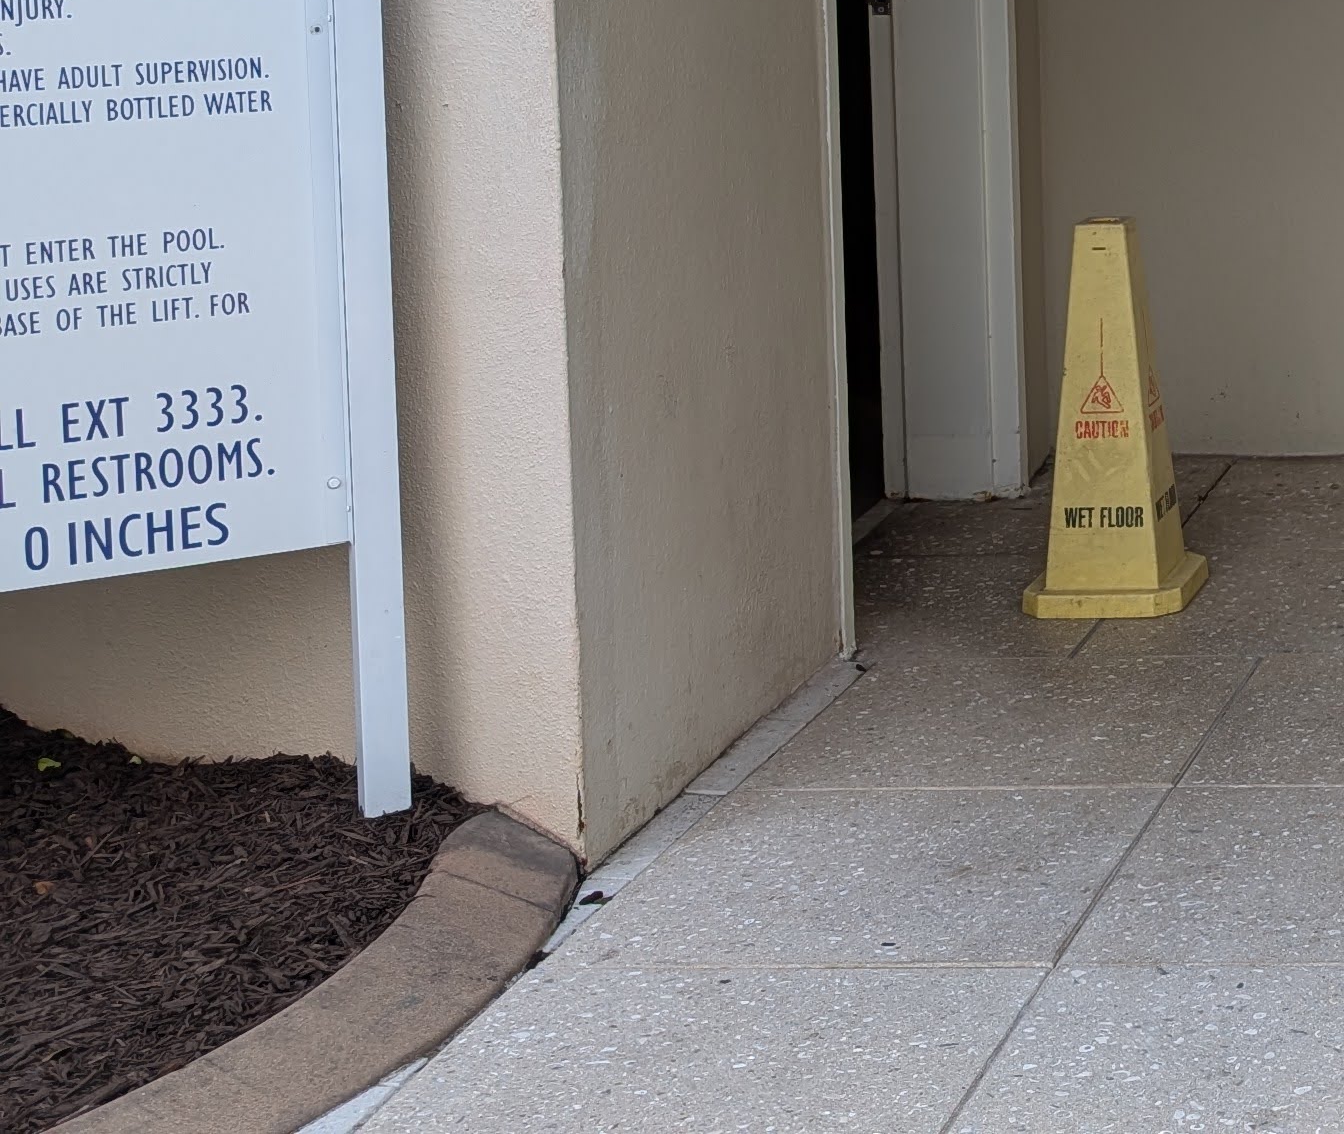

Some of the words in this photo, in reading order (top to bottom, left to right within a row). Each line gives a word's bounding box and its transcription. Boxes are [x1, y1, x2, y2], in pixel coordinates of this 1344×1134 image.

[58, 64, 122, 89] ADULT
[136, 57, 269, 85] SUPERVISION.
[0, 100, 92, 127] ERCIALLY
[107, 95, 194, 121] BOTTLED
[204, 90, 272, 115] WATER
[26, 239, 95, 265] ENTER
[107, 234, 147, 257] THE
[164, 228, 224, 253] POOL.
[6, 276, 55, 301] USES
[68, 271, 107, 296] ARE
[122, 262, 211, 291] STRICTLY
[0, 312, 40, 336] ASE
[56, 308, 82, 331] OF
[96, 303, 136, 327] THE
[152, 297, 199, 322] LIFT.
[210, 293, 249, 316] FOR
[62, 397, 129, 443] EXT
[157, 385, 262, 432] 3333.
[1075, 420, 1129, 439] CAUTION
[42, 437, 275, 503] RESTROOMS.
[67, 502, 229, 565] INCHES
[1064, 507, 1094, 529] WET
[1099, 506, 1144, 528] FLOOR
